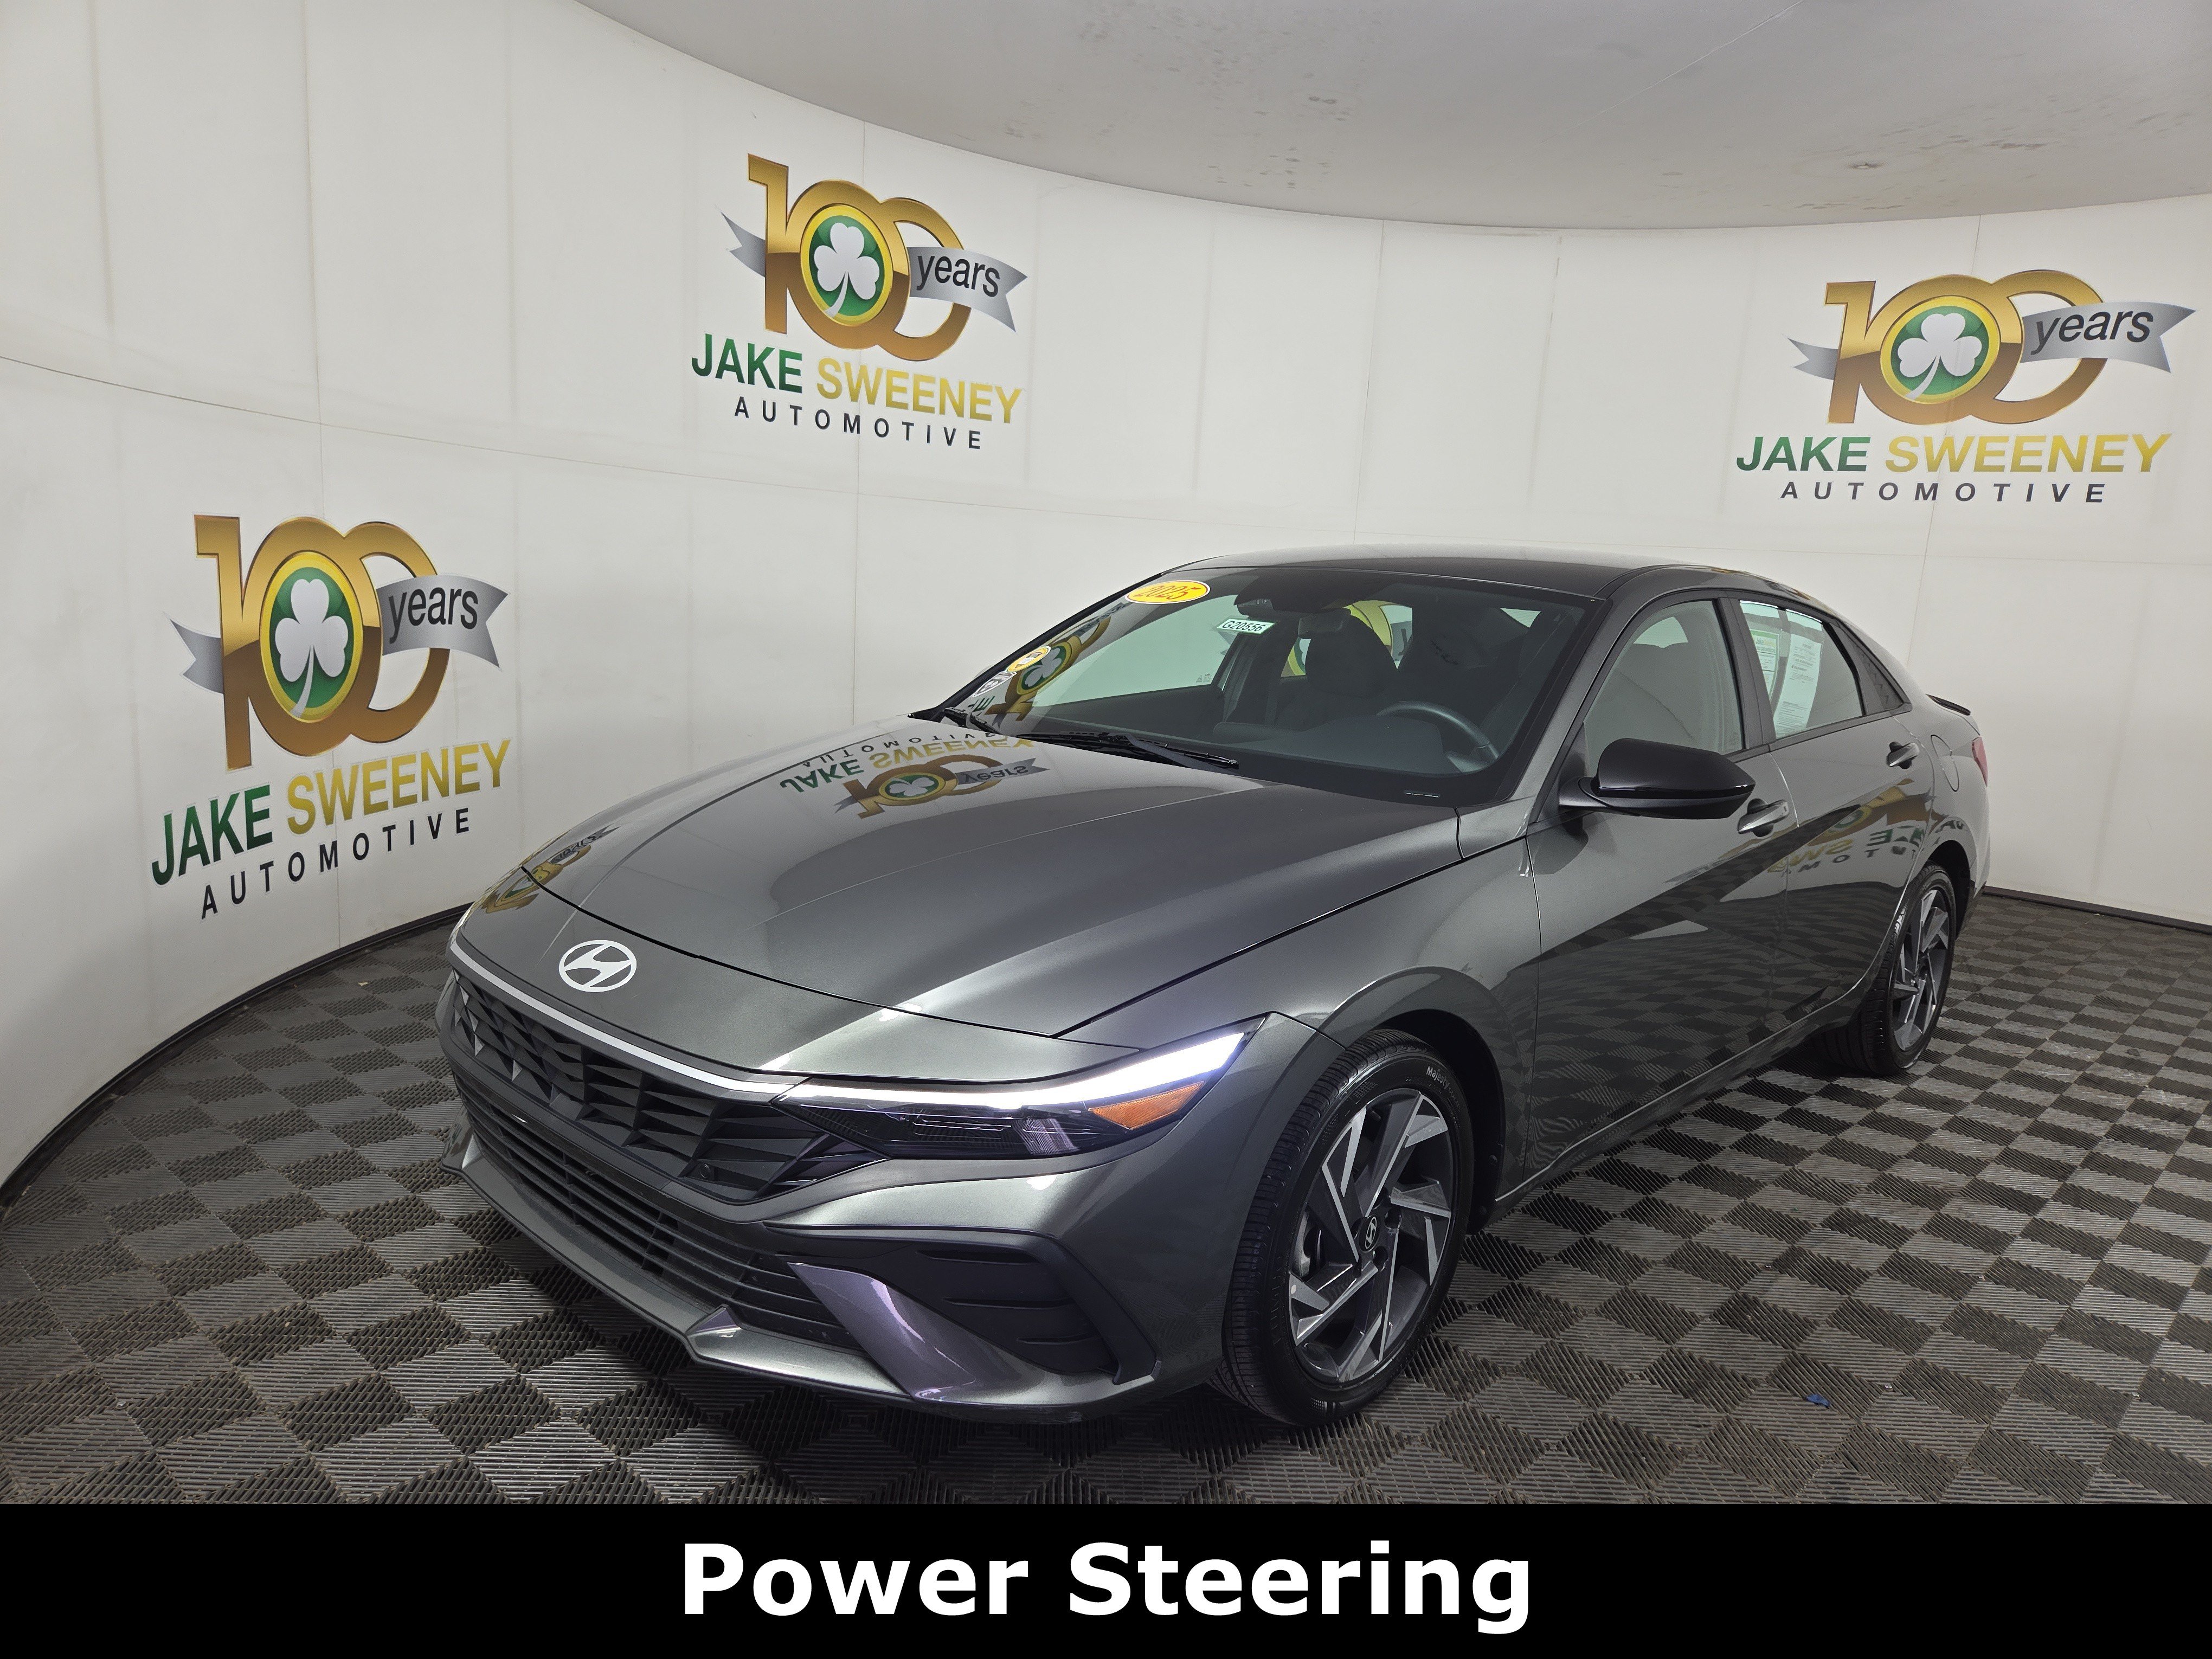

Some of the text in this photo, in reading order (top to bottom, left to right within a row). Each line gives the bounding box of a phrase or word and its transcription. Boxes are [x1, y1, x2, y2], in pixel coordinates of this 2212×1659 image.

[748, 153, 972, 362] 100
[916, 254, 1000, 298] years
[1824, 269, 2108, 425] 100
[2030, 310, 2155, 356] years
[691, 333, 1023, 424] JAKE SWEENEY
[734, 396, 981, 449] AUTOMOTIVE
[1737, 434, 2171, 473] JAKE SWEENEY
[1780, 481, 2105, 503] AUTOMOTIVE
[388, 586, 479, 644] years
[1134, 585, 1201, 600] 2025
[194, 514, 451, 770] 100
[1222, 620, 1266, 632] G20556
[152, 739, 512, 885] JAKE SWEENEY
[201, 807, 470, 920] AUTOMOTIVE
[1426, 1065, 1450, 1090] Majesty
